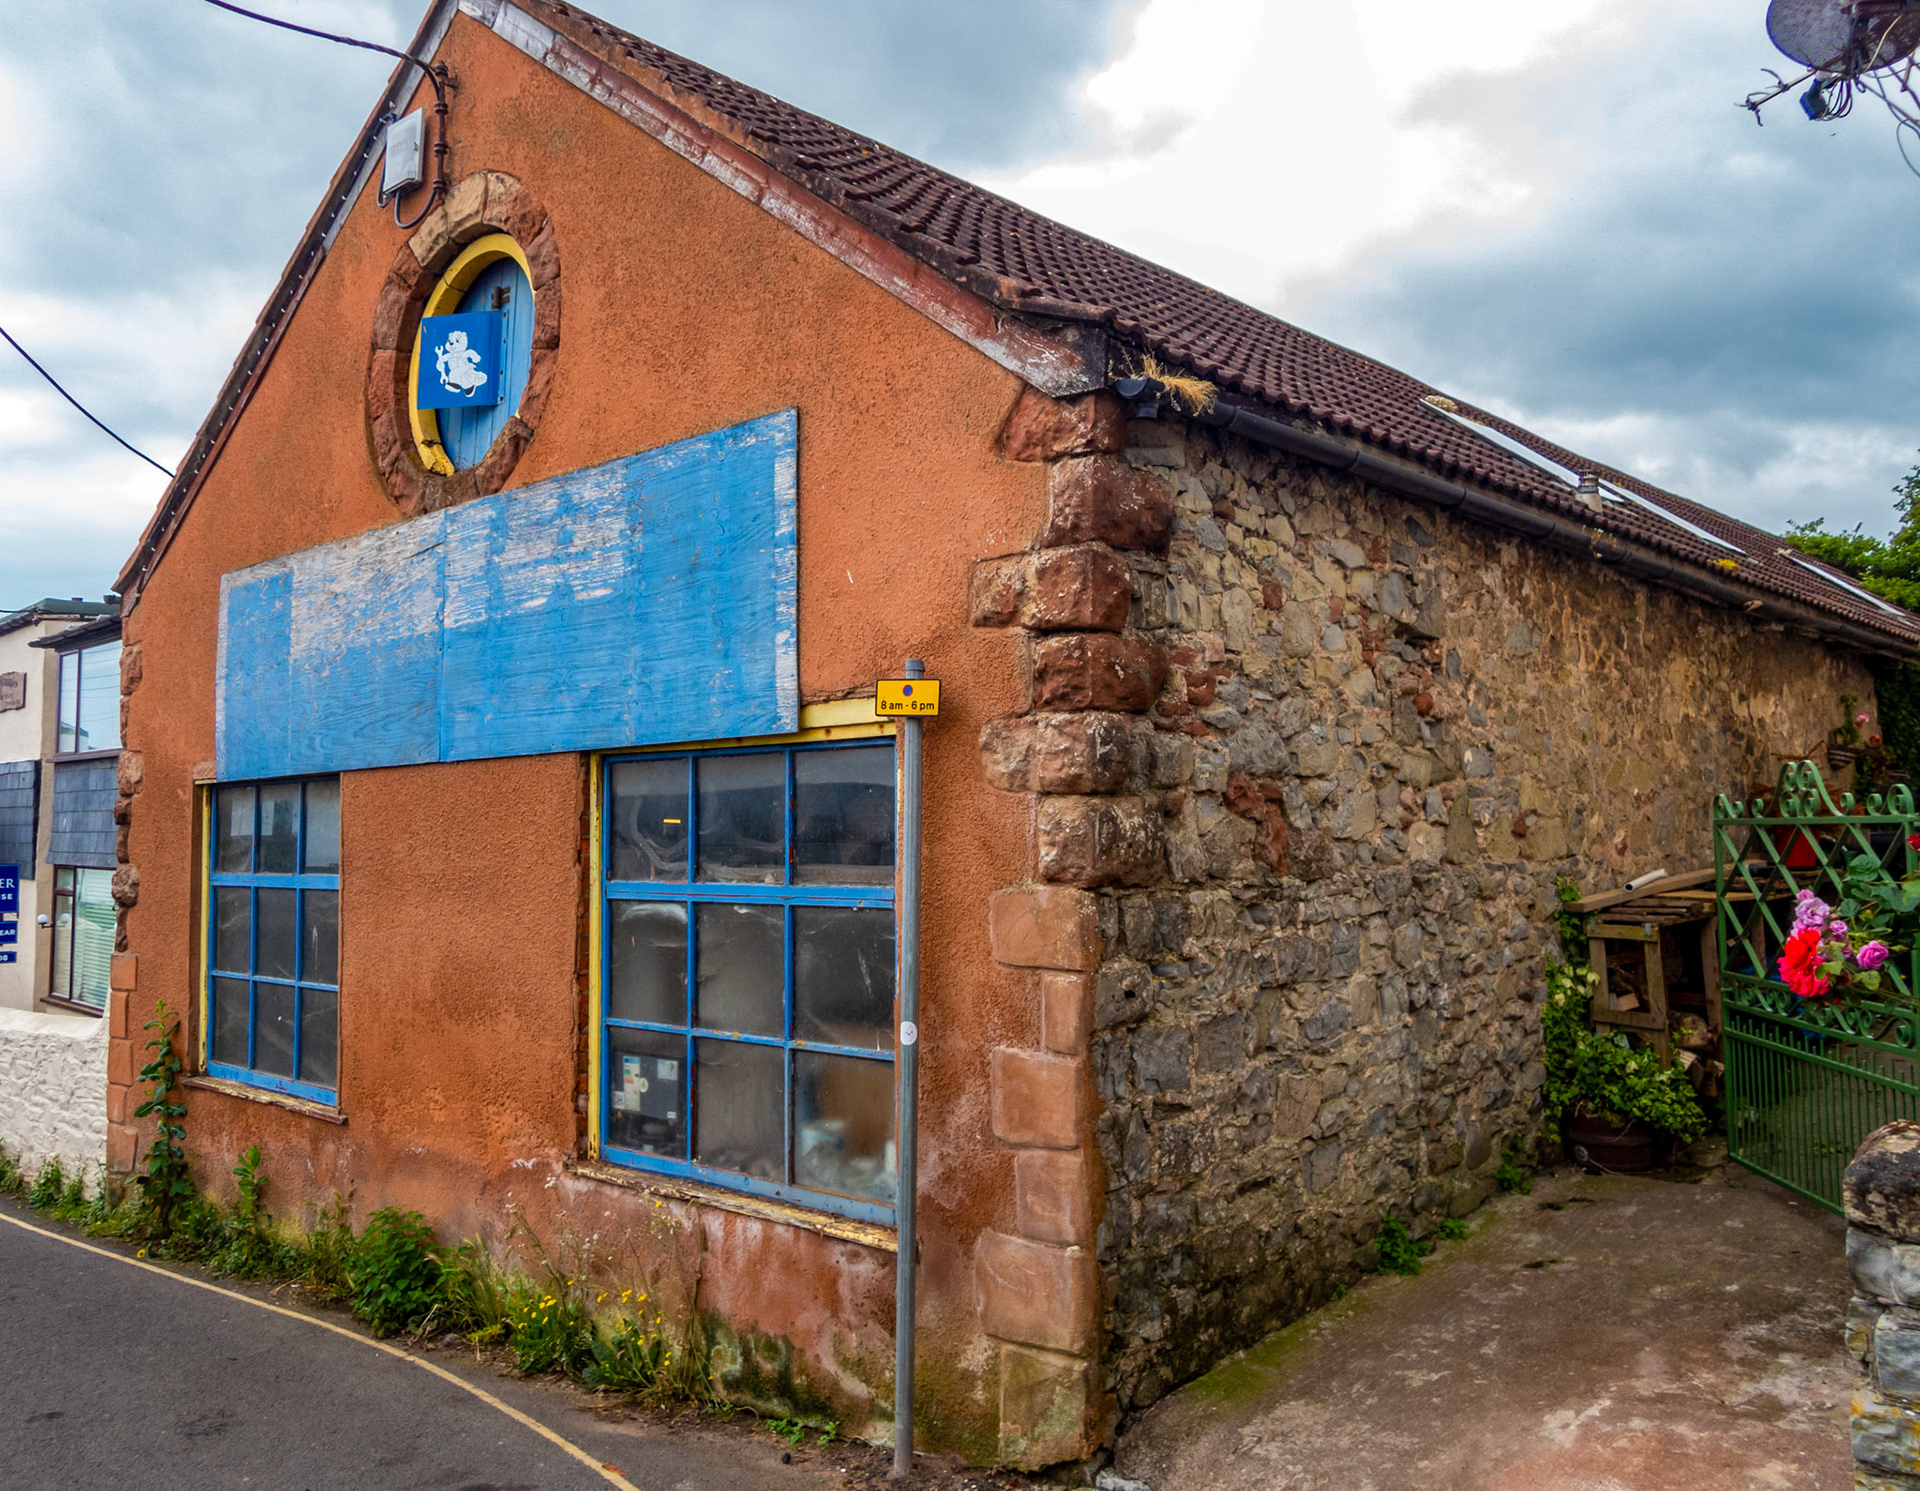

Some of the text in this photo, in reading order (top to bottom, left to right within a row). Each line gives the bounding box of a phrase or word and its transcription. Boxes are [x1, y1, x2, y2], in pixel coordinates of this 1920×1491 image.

[881, 700, 887, 710] 8
[889, 702, 903, 710] am
[911, 700, 918, 710] 6
[920, 702, 935, 711] pm
